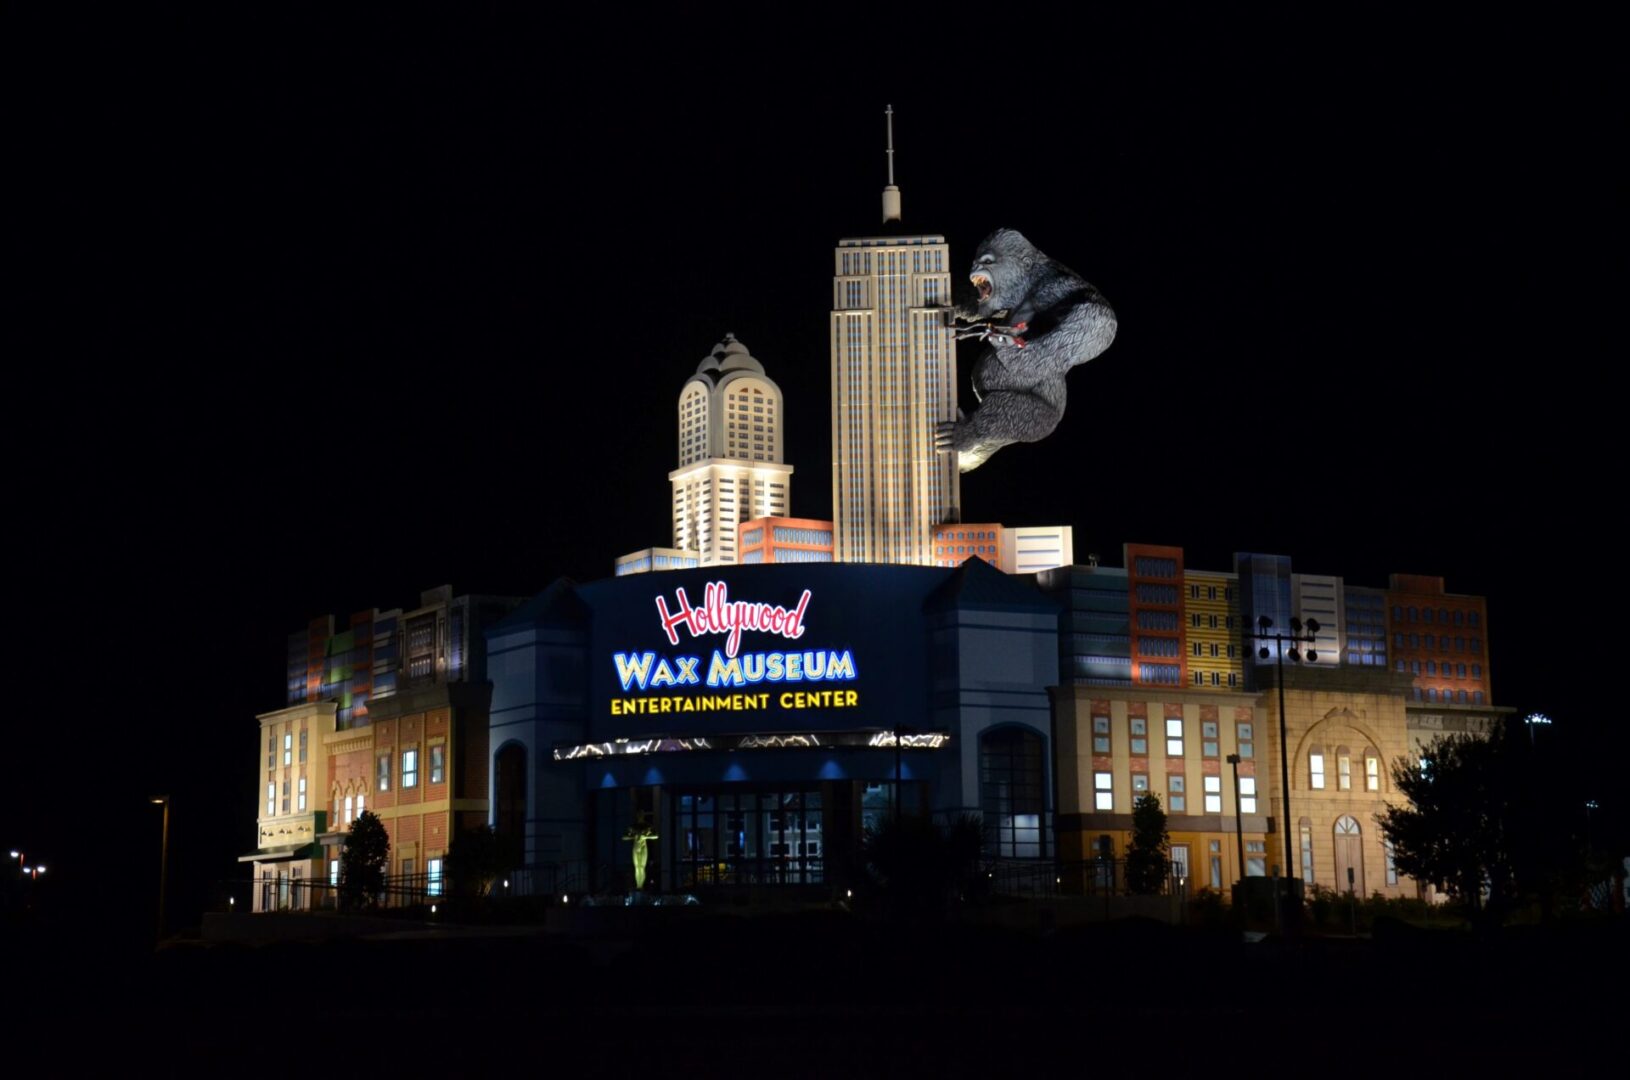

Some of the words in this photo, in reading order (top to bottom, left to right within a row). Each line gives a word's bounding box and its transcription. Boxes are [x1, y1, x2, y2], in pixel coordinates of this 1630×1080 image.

[655, 581, 812, 659] Hollywood
[611, 694, 769, 715] ENTERTAINMENT
[779, 690, 859, 710] CENTER
